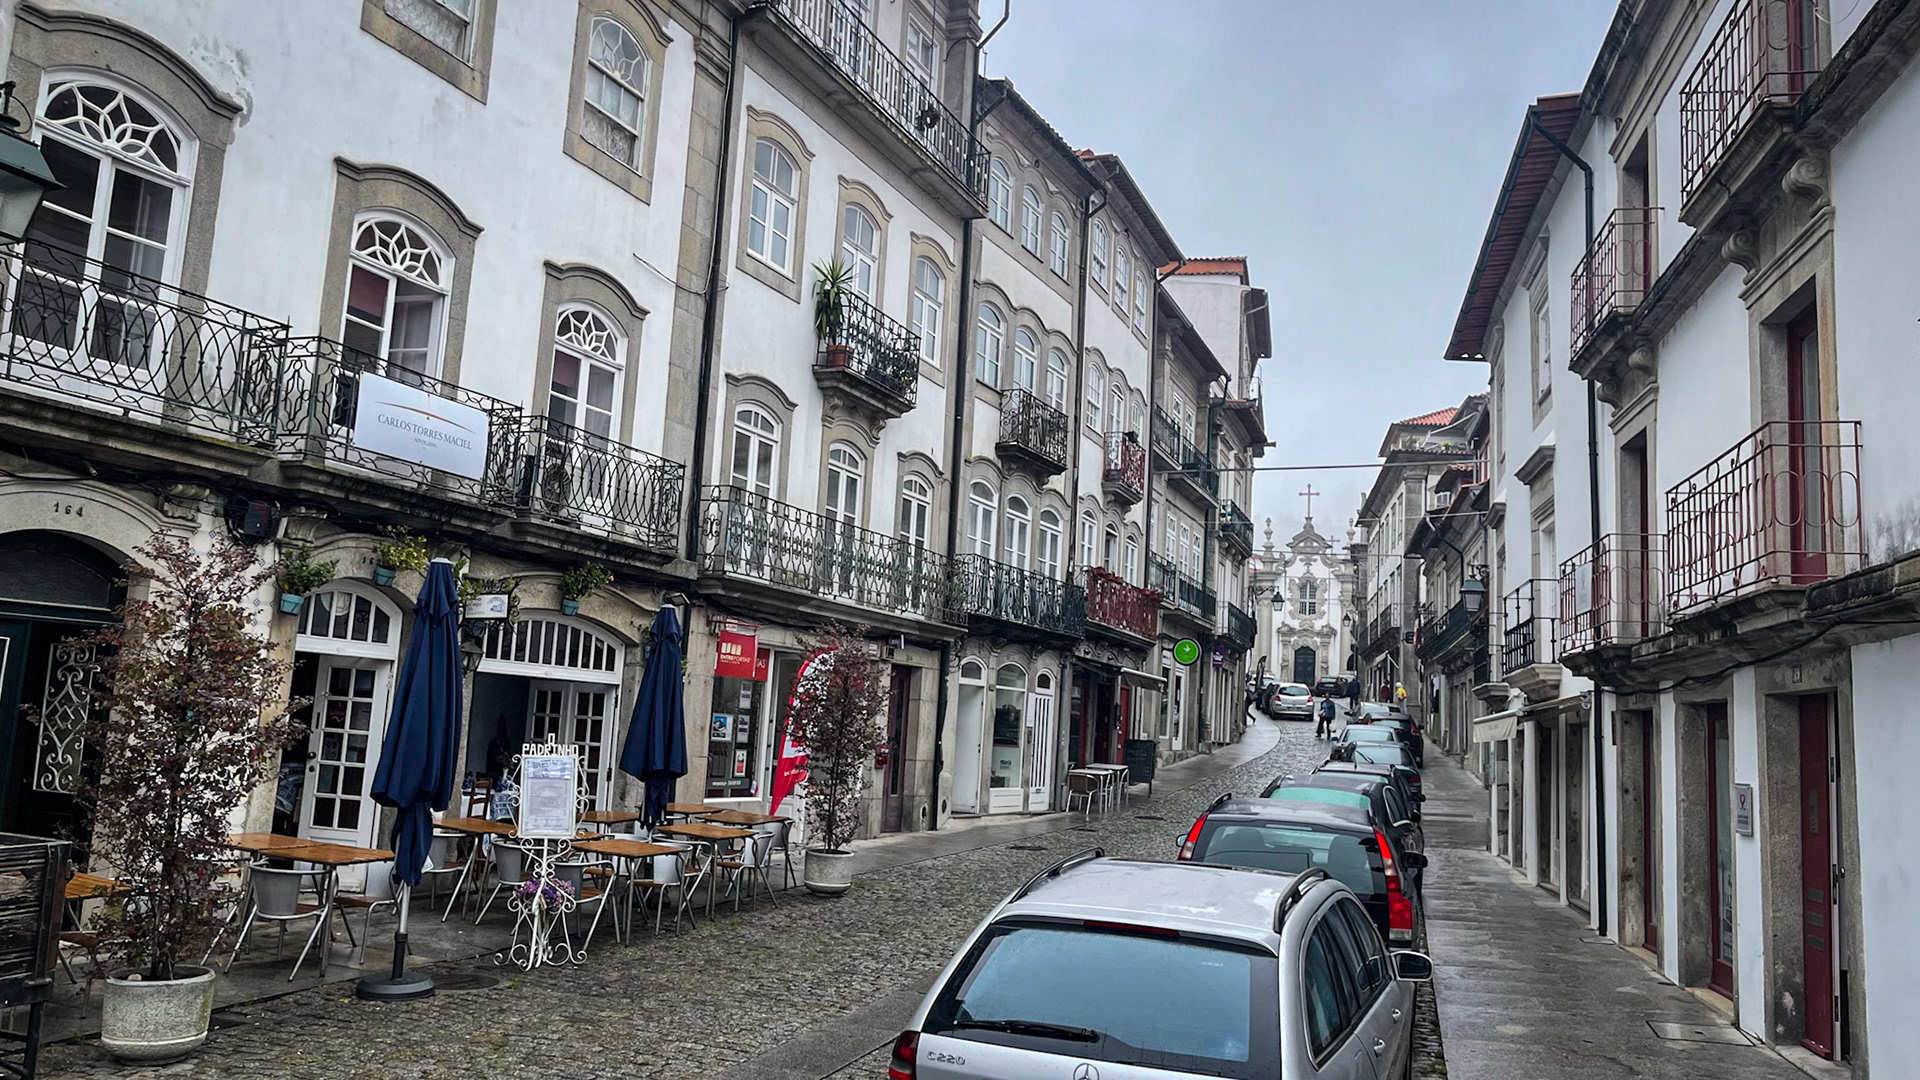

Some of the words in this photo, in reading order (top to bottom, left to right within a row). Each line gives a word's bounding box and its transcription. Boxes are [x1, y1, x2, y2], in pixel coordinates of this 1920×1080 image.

[377, 413, 412, 431] CARLOS
[412, 424, 444, 441] TORRES
[444, 433, 472, 450] MACIEL
[53, 501, 84, 518] 164
[522, 743, 579, 756] PADRINHO
[926, 1051, 967, 1066] C220
